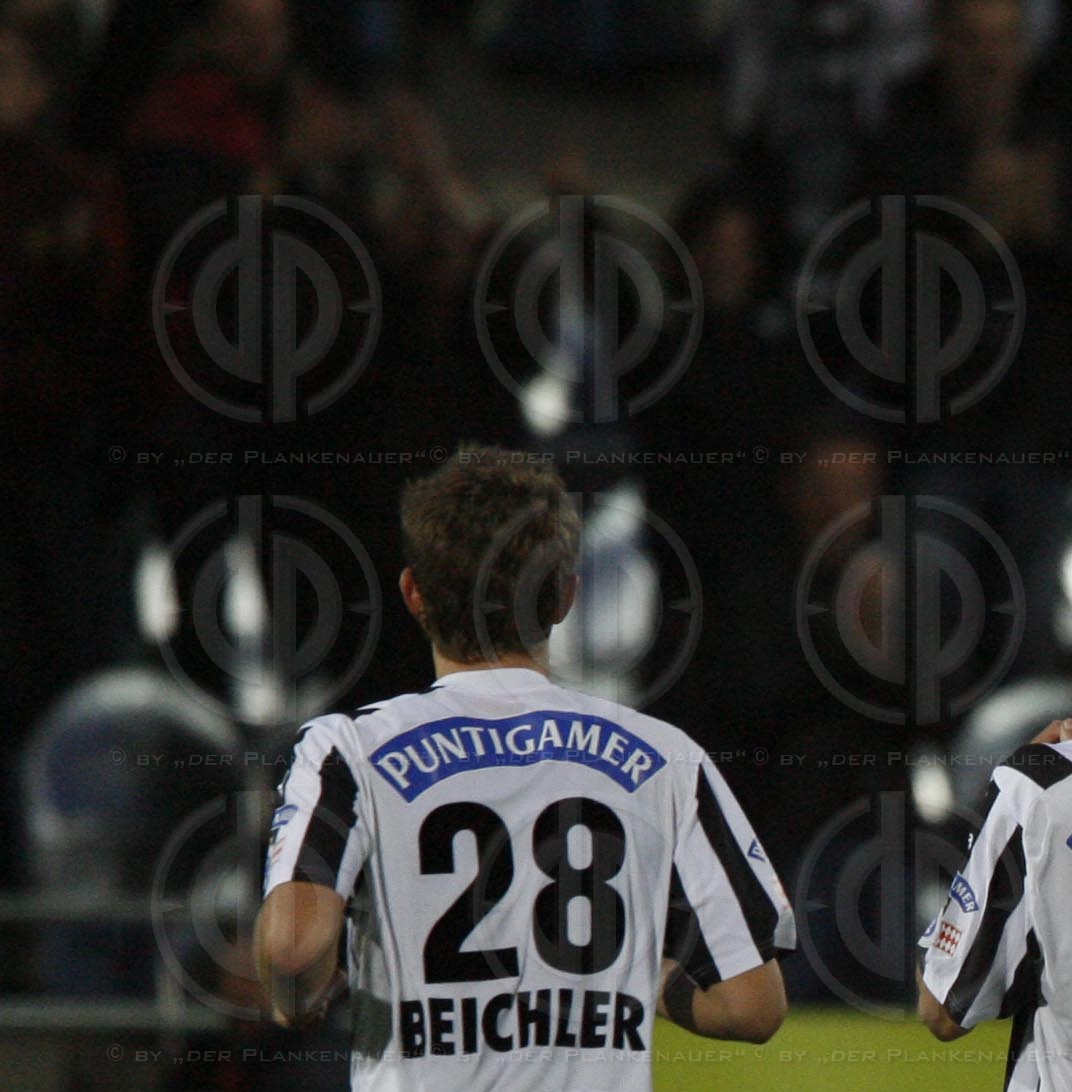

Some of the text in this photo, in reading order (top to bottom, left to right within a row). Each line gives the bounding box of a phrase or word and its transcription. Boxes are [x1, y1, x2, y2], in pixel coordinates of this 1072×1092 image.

[377, 719, 653, 791] PUNTIGAMER
[418, 796, 627, 985] 28
[400, 987, 646, 1058] BEICHLER
